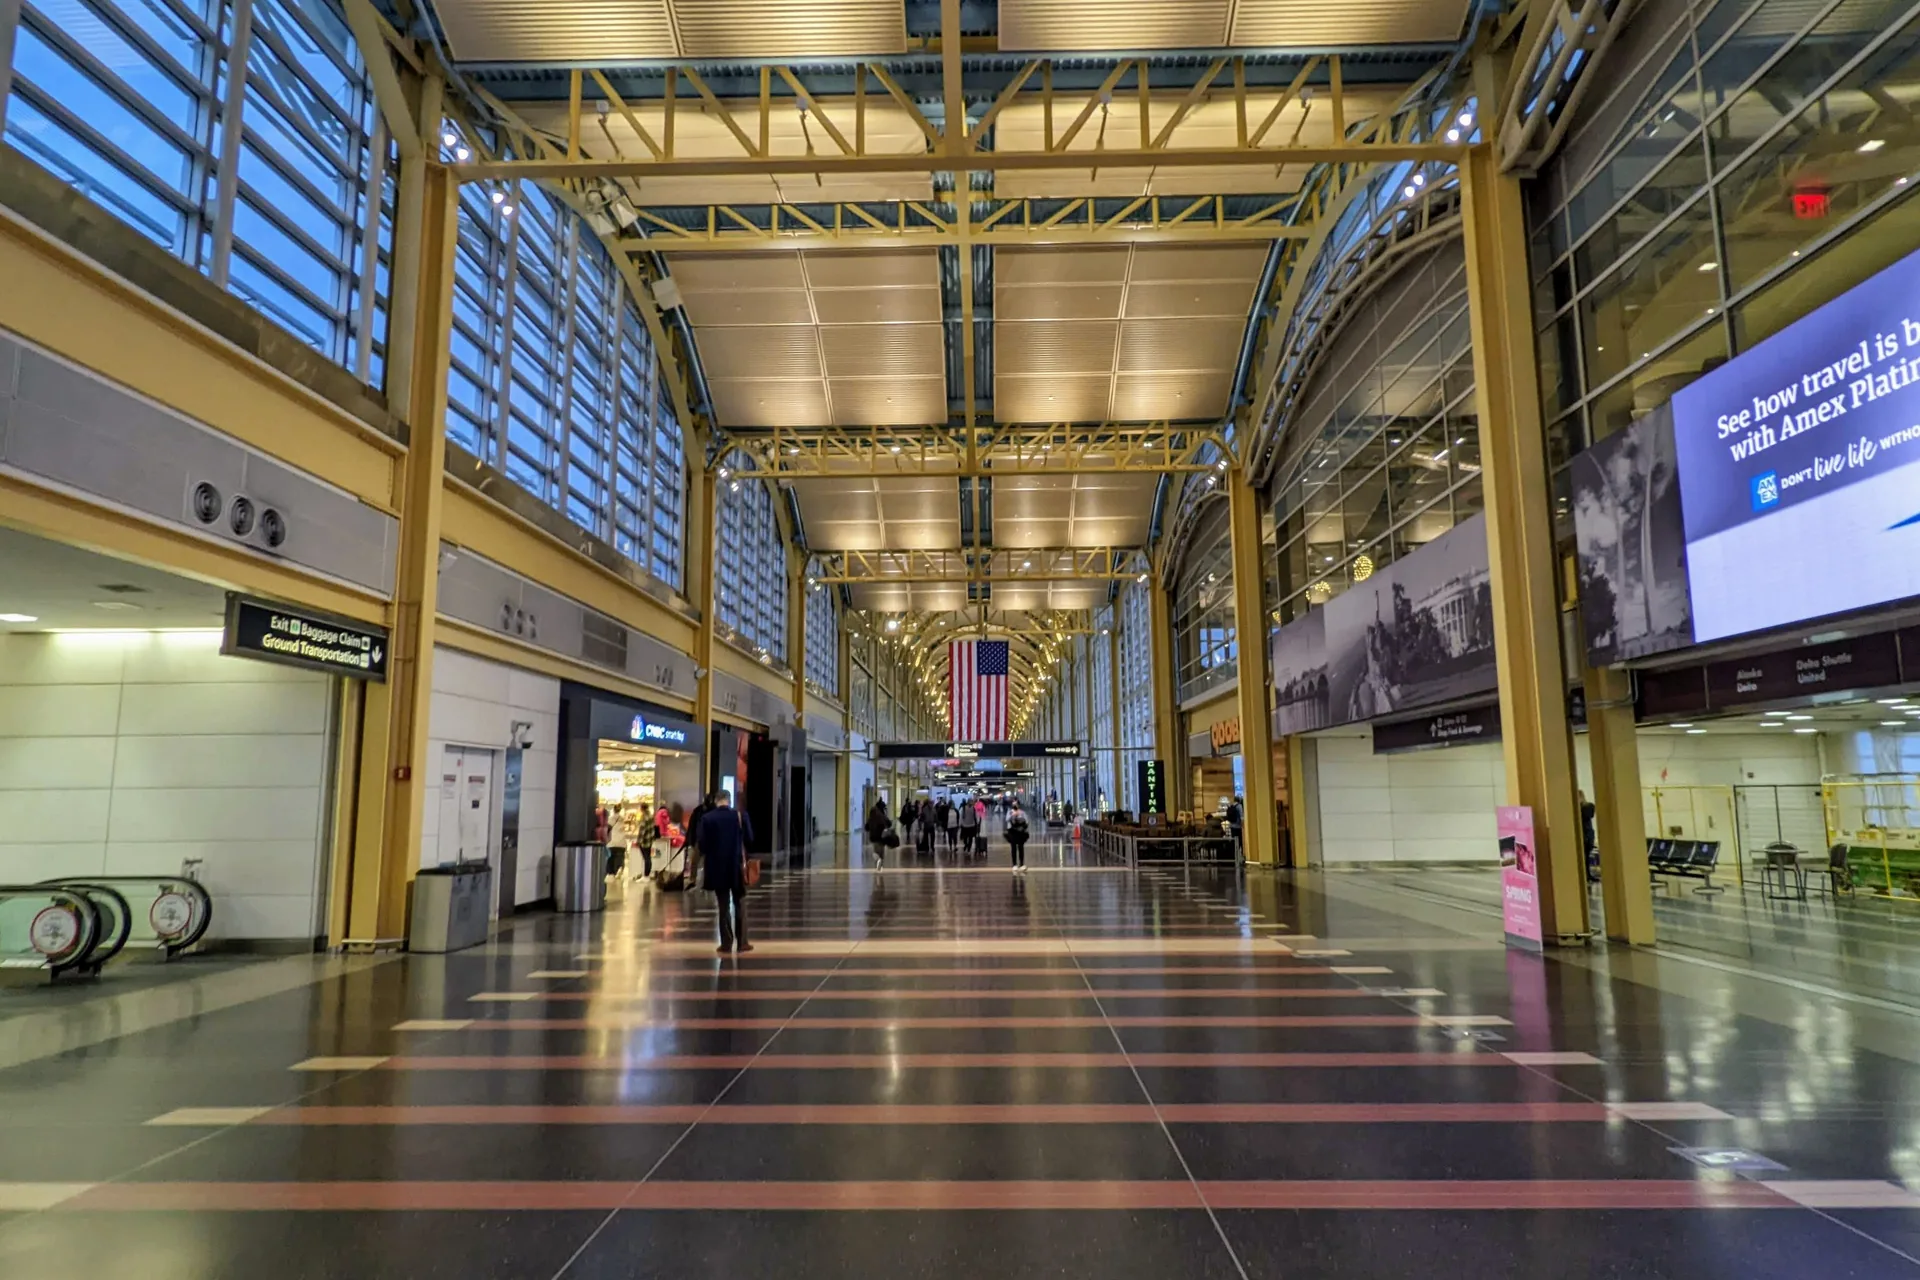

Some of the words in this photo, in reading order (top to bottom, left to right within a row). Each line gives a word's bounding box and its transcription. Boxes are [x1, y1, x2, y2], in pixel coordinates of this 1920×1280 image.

[1717, 409, 1751, 439] See
[1752, 384, 1799, 422] how
[1802, 340, 1872, 397] travel
[1875, 332, 1899, 362] is
[1730, 424, 1777, 462] with
[1780, 393, 1847, 441] Amex
[1814, 453, 1846, 481] live
[1848, 436, 1878, 468] life
[262, 633, 299, 653] Ground
[300, 641, 360, 666] Transportation
[270, 616, 289, 630] Exit
[301, 623, 338, 645] Baggage
[339, 632, 361, 648] Claim
[1147, 760, 1157, 813] CANTINA
[1505, 885, 1532, 904] SPRING
